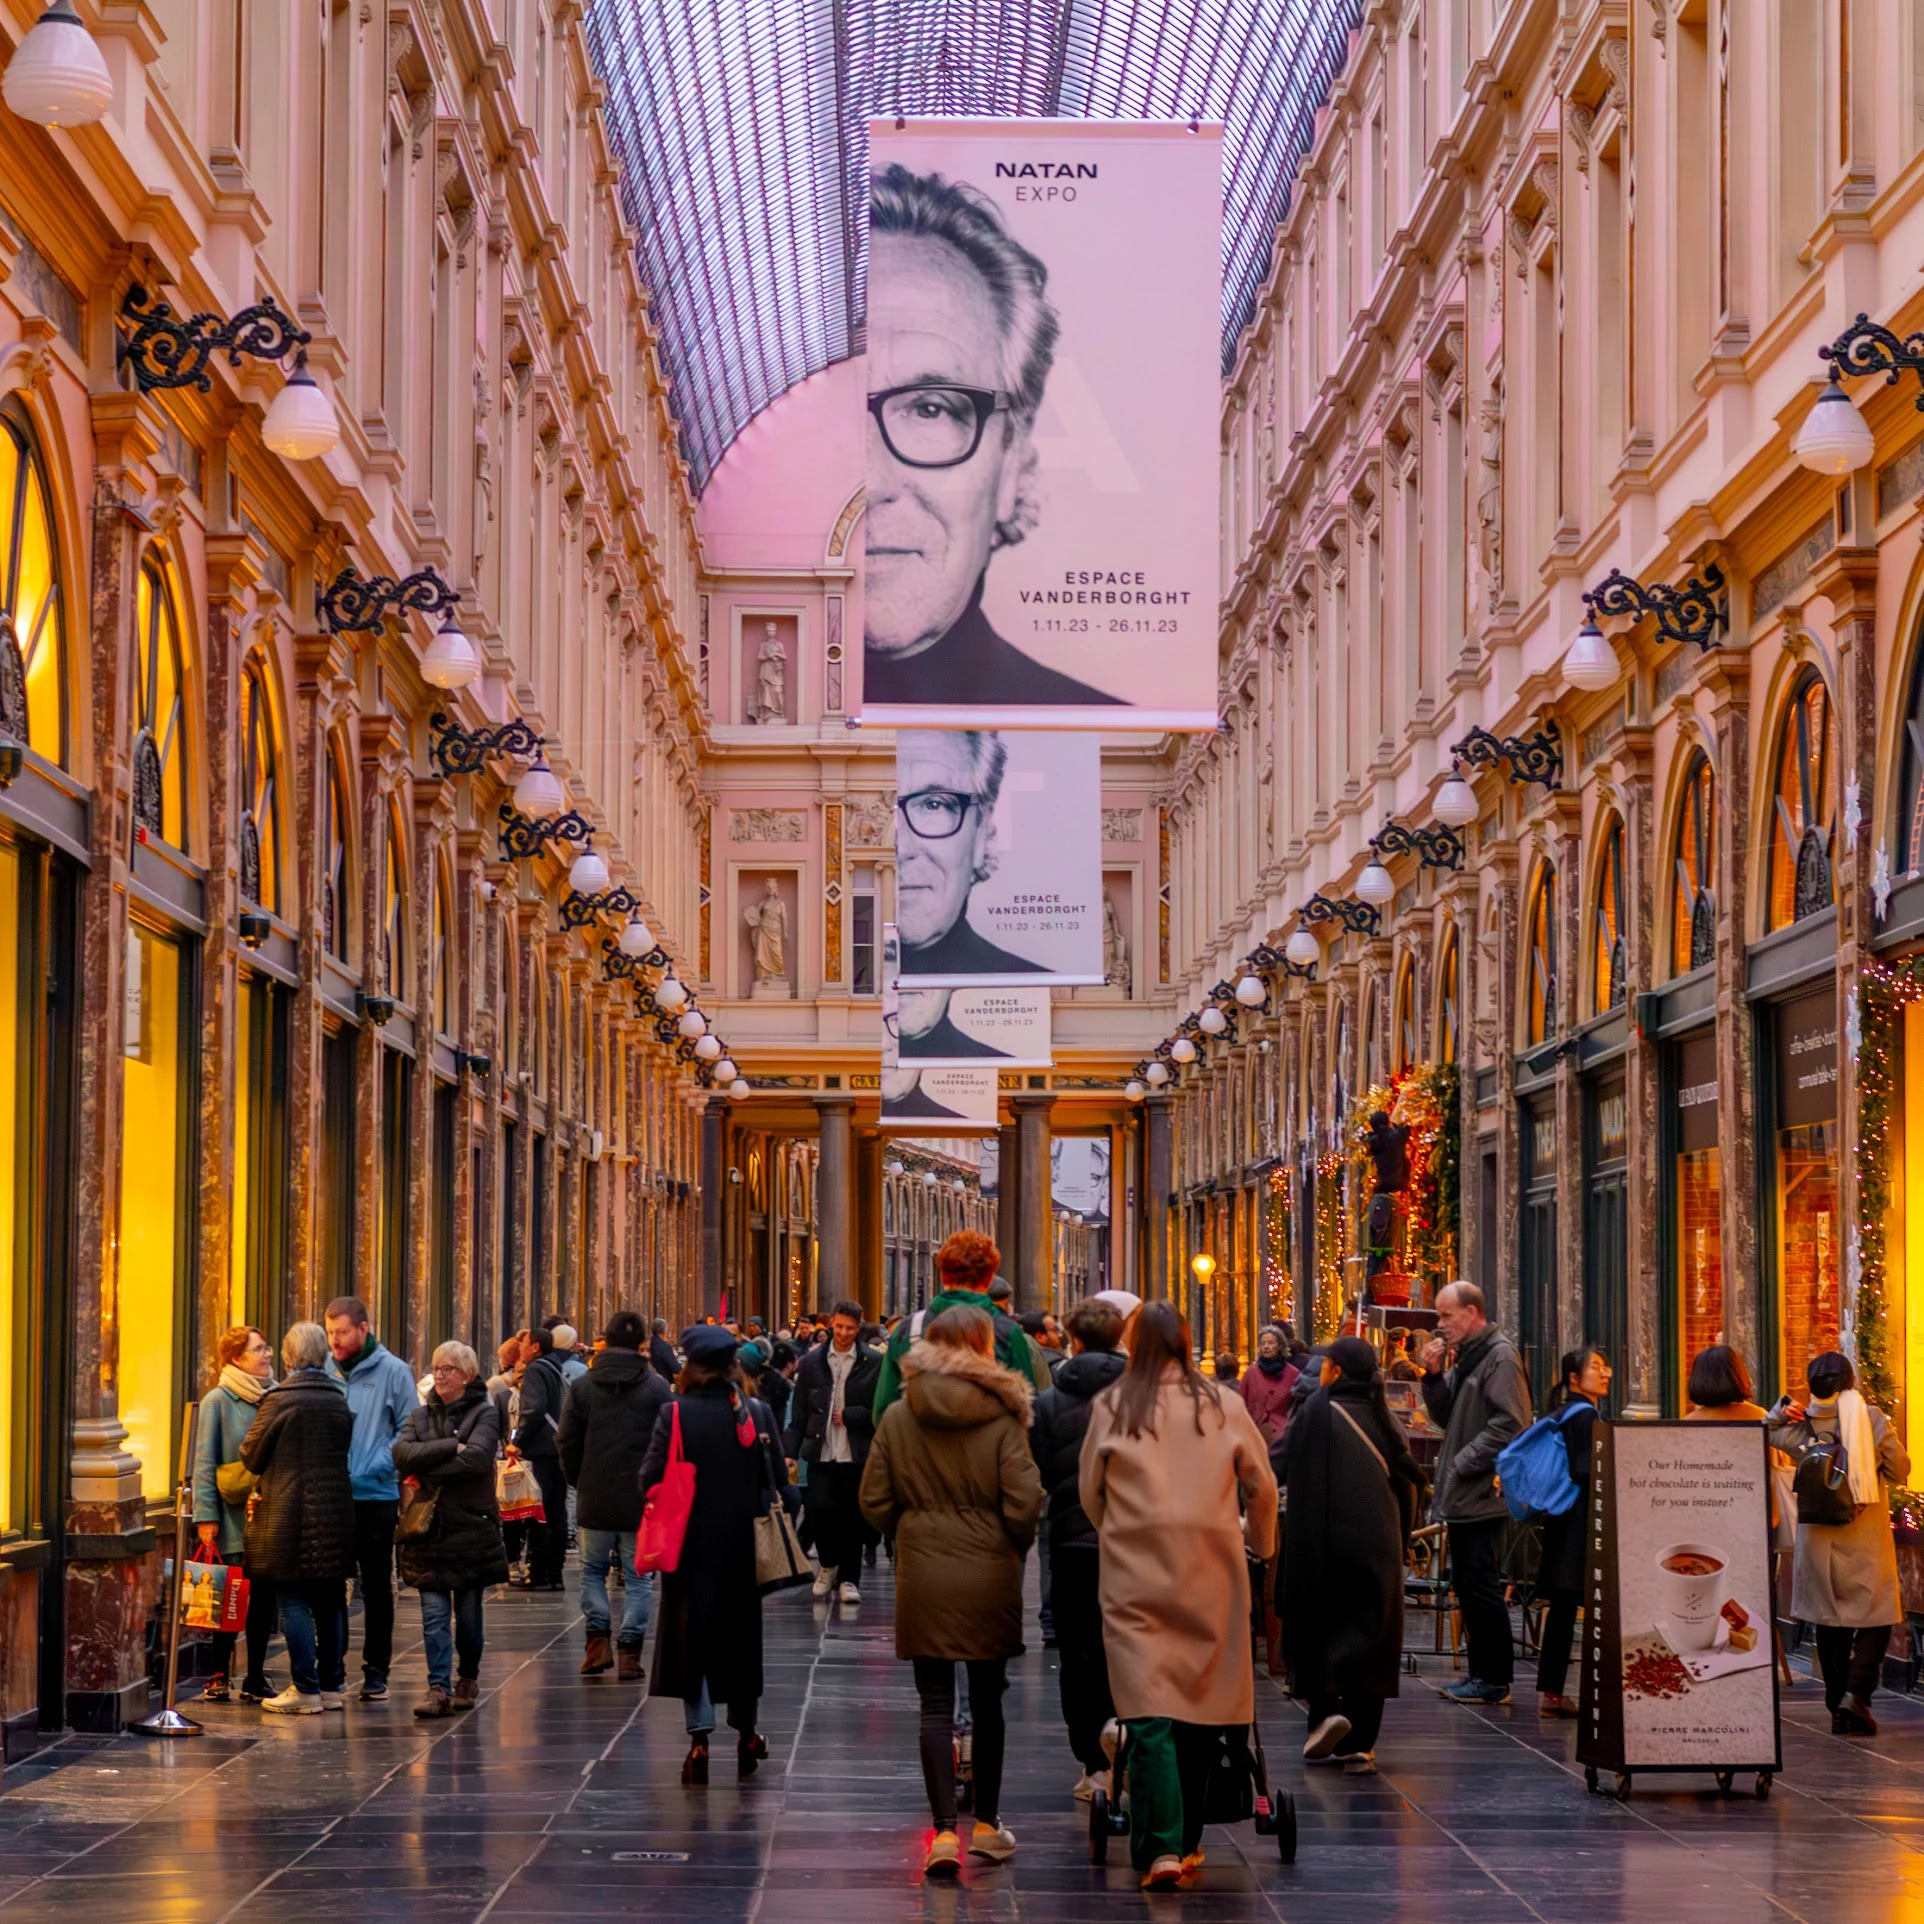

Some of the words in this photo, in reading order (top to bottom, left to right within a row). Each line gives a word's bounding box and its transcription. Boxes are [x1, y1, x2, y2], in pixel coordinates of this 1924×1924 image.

[996, 162, 1098, 178] NATAN
[1016, 186, 1077, 202] EXPO
[1065, 571, 1146, 585] ESPACE
[1019, 591, 1191, 604] VANDERBORGHT
[1033, 620, 1089, 633] 1.11.23
[1109, 620, 1178, 633] 26.11.23
[1013, 895, 1061, 904] ESPACE
[988, 905, 1087, 915] VANDERBORGHT
[996, 923, 1029, 931] 1.11.23
[1040, 922, 1080, 931] 26.11.23
[964, 1007, 1038, 1015] VANDERBORGHT
[1648, 1459, 1671, 1471] Our
[1674, 1459, 1734, 1471] Homemade
[1629, 1477, 1646, 1489] hot
[1649, 1477, 1699, 1489] chocolate
[1702, 1478, 1711, 1489] is
[1714, 1478, 1755, 1491] waiting
[1594, 1440, 1603, 1551] PIERRE
[1651, 1496, 1666, 1508] for
[1670, 1499, 1689, 1508] you
[1692, 1496, 1734, 1508] instore!
[227, 1578, 243, 1620] CAMPER
[1593, 1568, 1602, 1740] MARCOLINI
[1692, 1726, 1750, 1734] MARCOLINI
